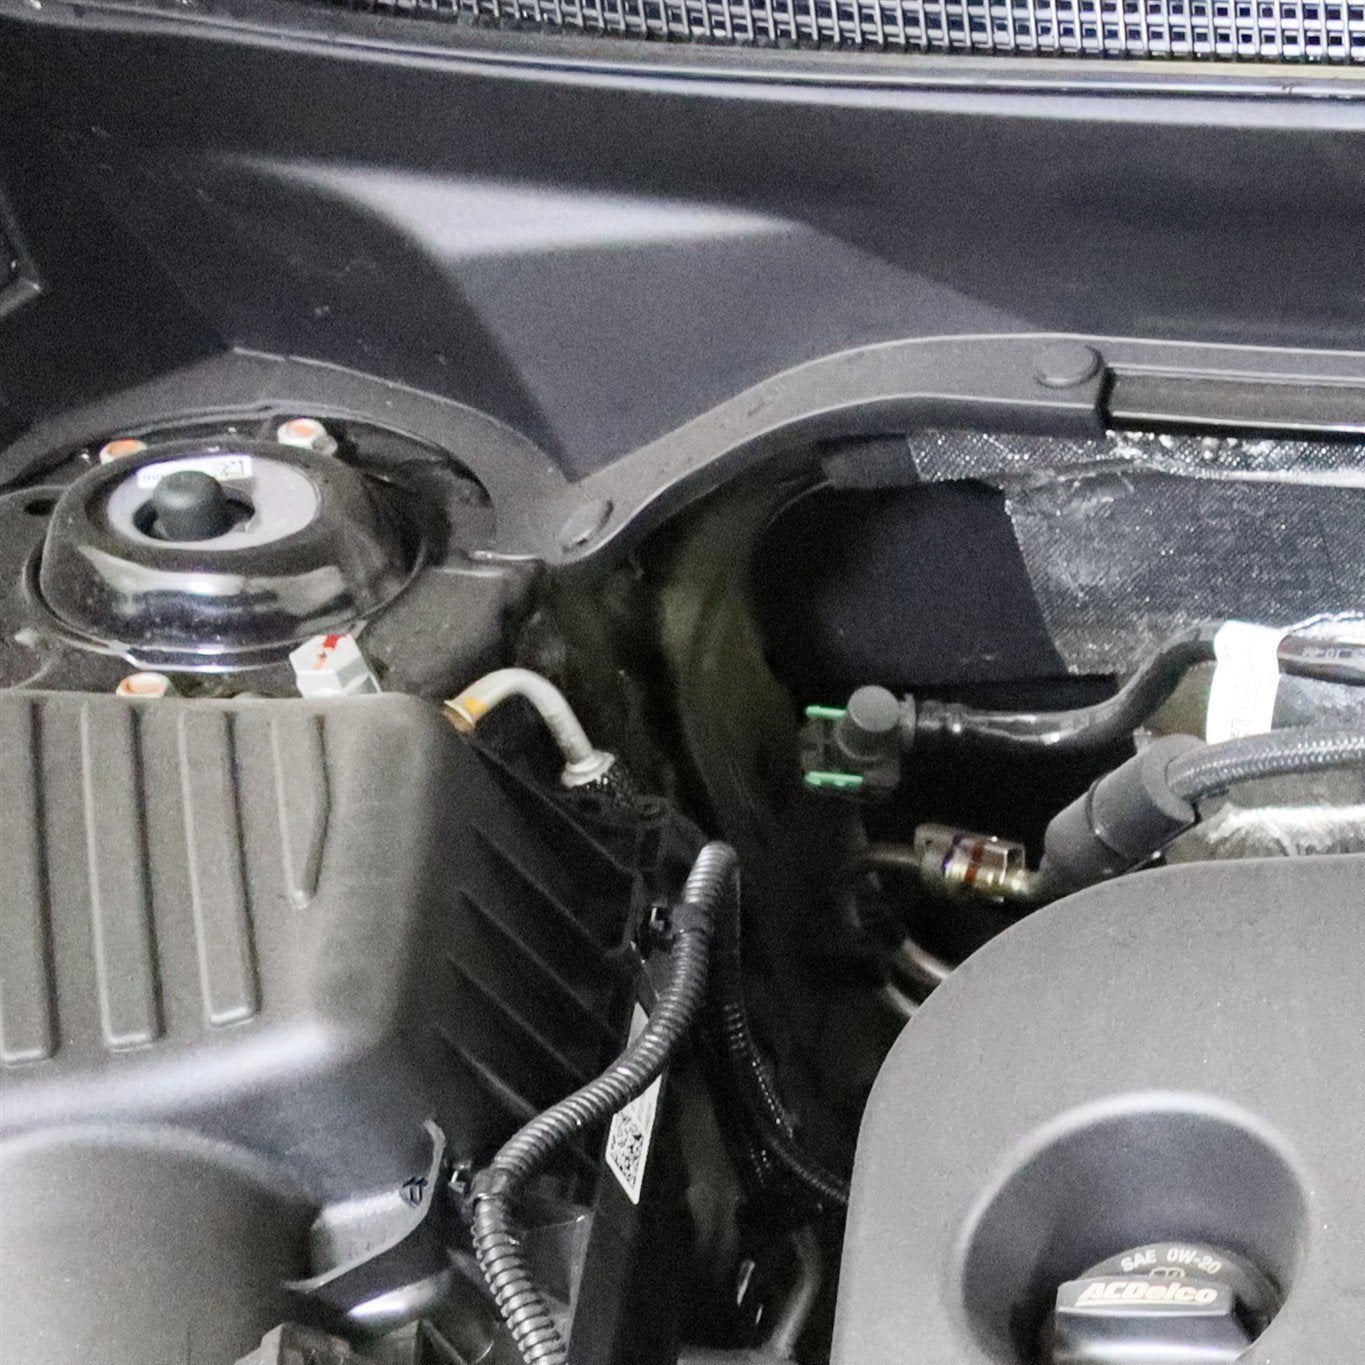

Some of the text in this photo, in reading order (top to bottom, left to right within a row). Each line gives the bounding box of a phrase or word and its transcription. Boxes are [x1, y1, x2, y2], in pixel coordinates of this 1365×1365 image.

[1120, 1247, 1222, 1275] SAE 0W-20
[1077, 1281, 1219, 1306] ACDelco
